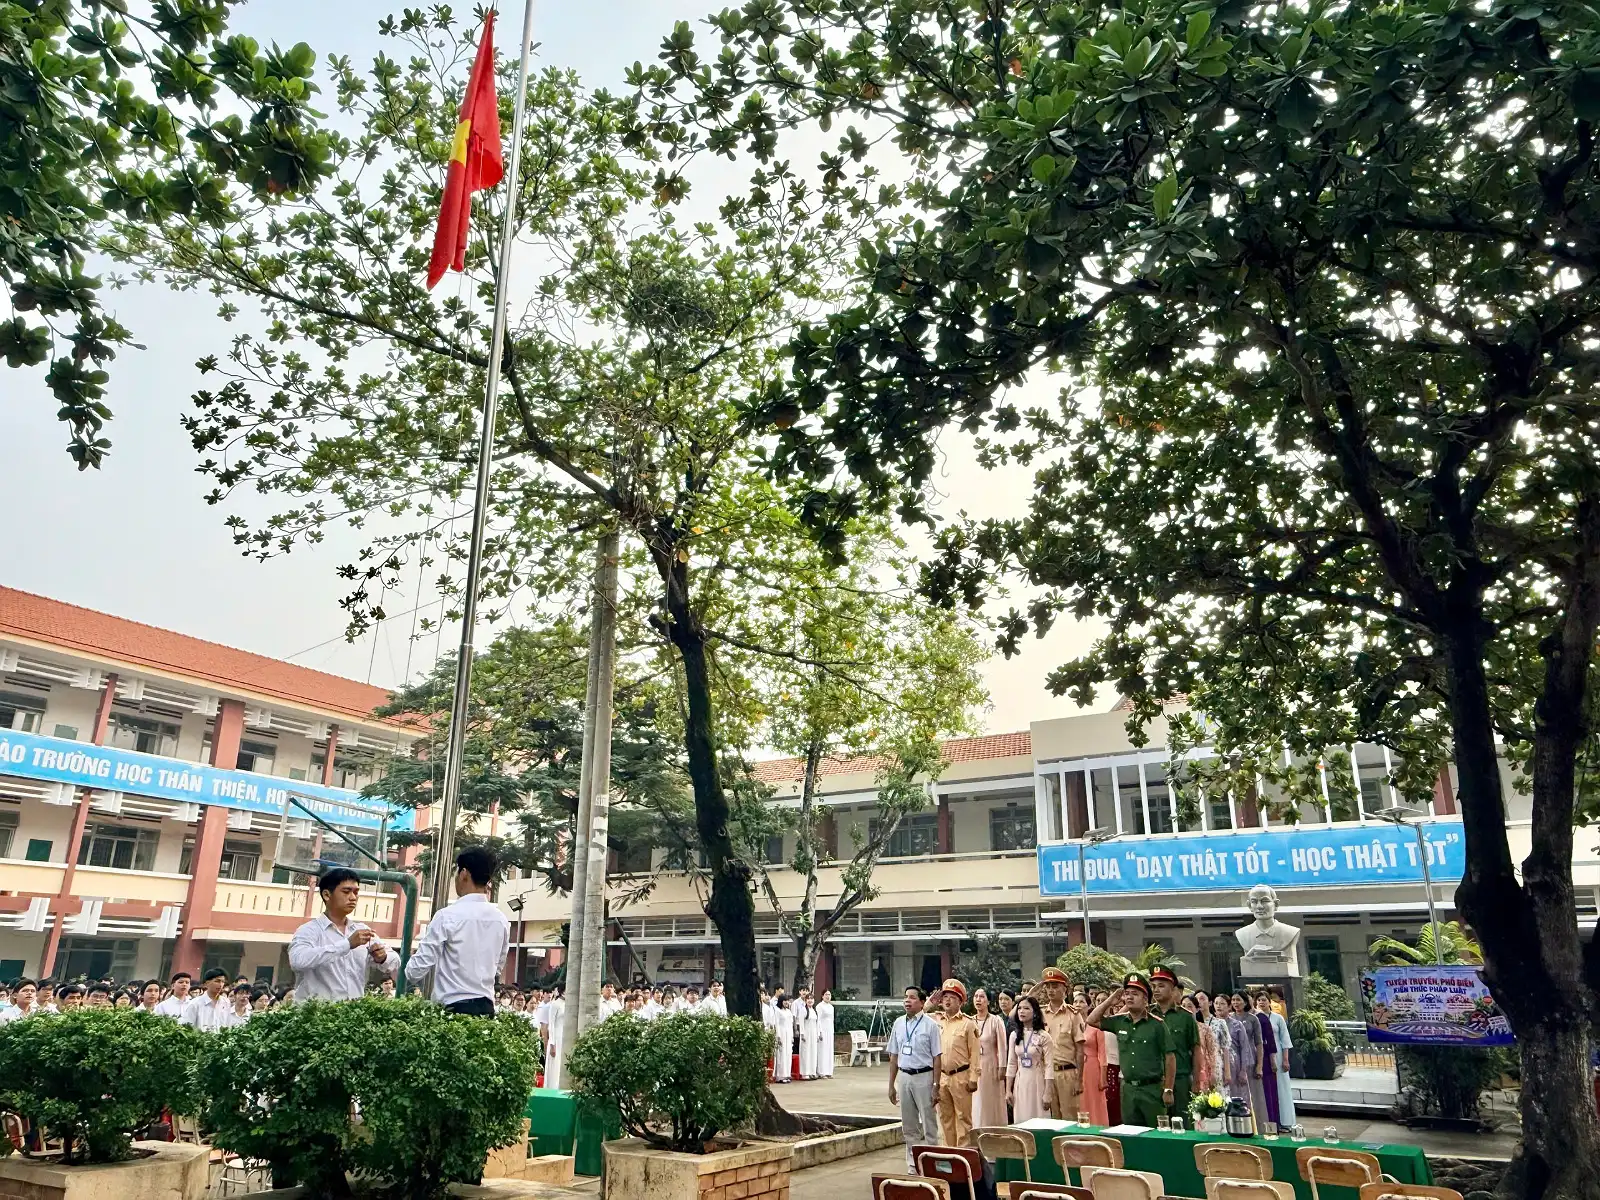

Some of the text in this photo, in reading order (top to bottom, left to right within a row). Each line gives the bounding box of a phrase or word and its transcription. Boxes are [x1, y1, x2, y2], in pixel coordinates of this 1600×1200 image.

[32, 748, 111, 778] TRƯỜNG
[115, 762, 153, 786] HỌC
[158, 770, 203, 793] THÂN
[212, 779, 261, 804] THIỆN,
[265, 787, 295, 809] HỌ
[1052, 860, 1080, 882] THI
[1084, 857, 1121, 880] ĐUA
[1125, 851, 1174, 882] “DẠY
[1179, 848, 1227, 880] THẬT
[1233, 842, 1270, 874] TỐT
[1291, 846, 1336, 876] HỌC
[1341, 839, 1398, 873] THẬT
[1404, 833, 1459, 866] TỐT”
